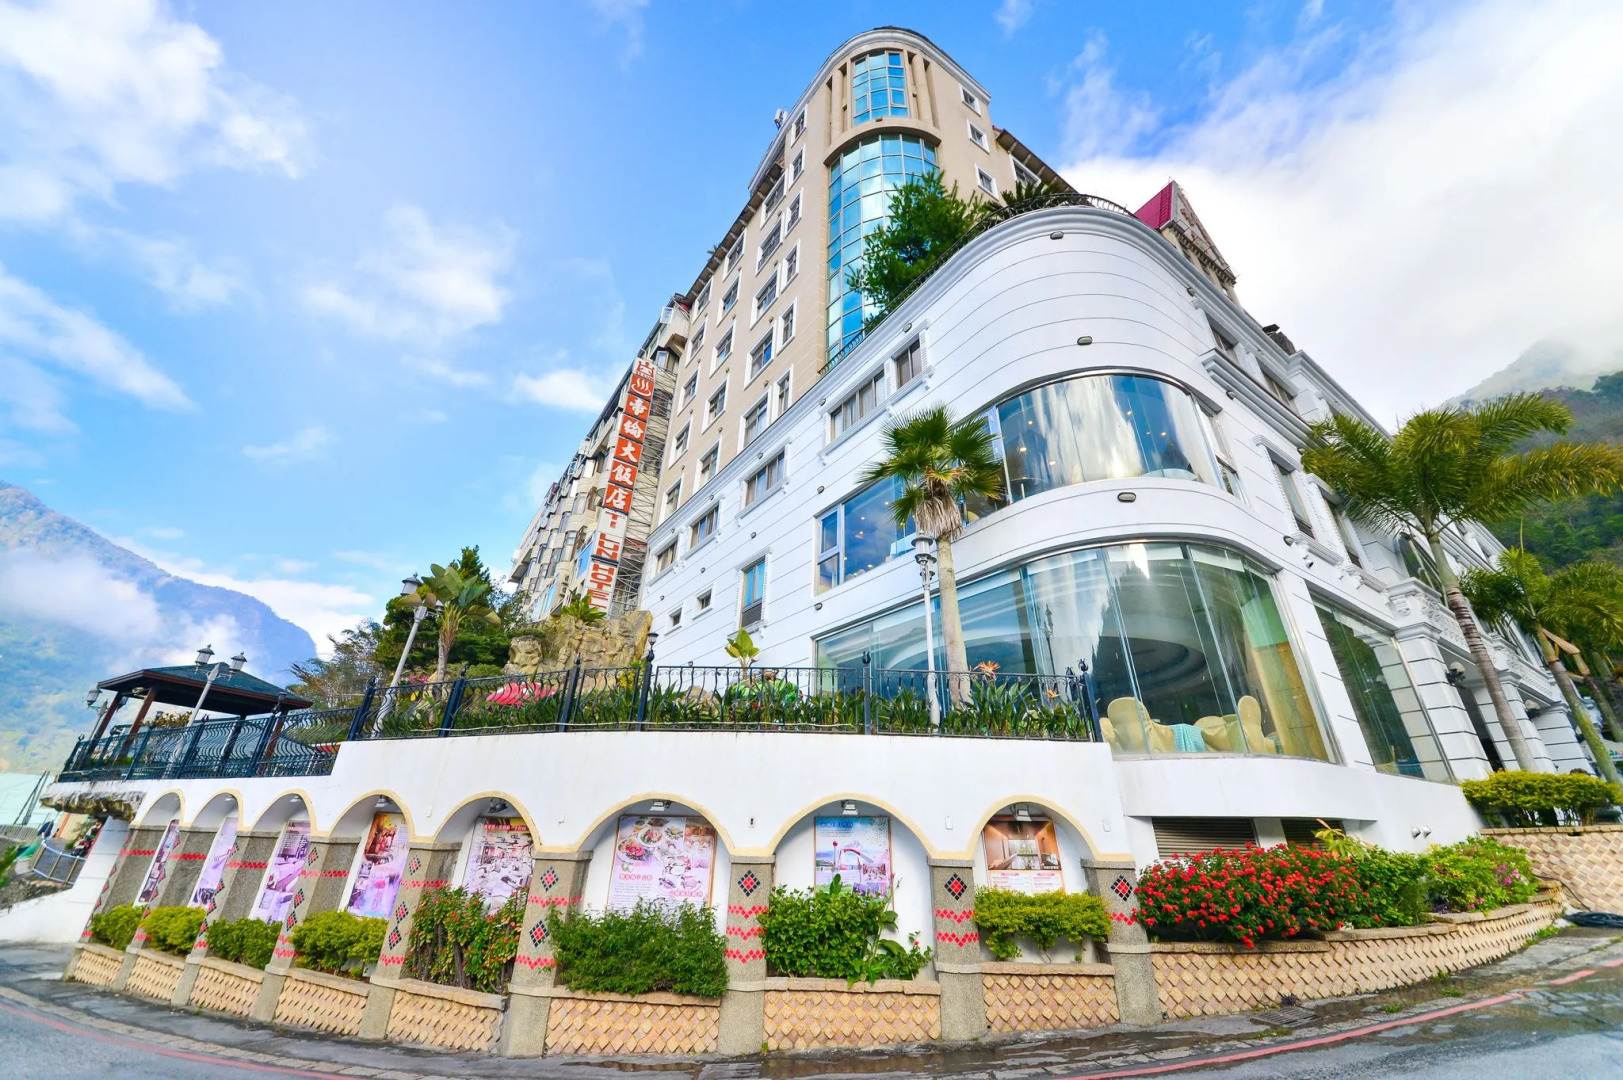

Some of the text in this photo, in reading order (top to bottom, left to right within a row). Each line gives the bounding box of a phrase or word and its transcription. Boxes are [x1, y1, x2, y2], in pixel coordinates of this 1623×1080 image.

[605, 397, 648, 510] 帝綸大飯店
[596, 532, 620, 560] LUN
[587, 563, 615, 609] HOTEL
